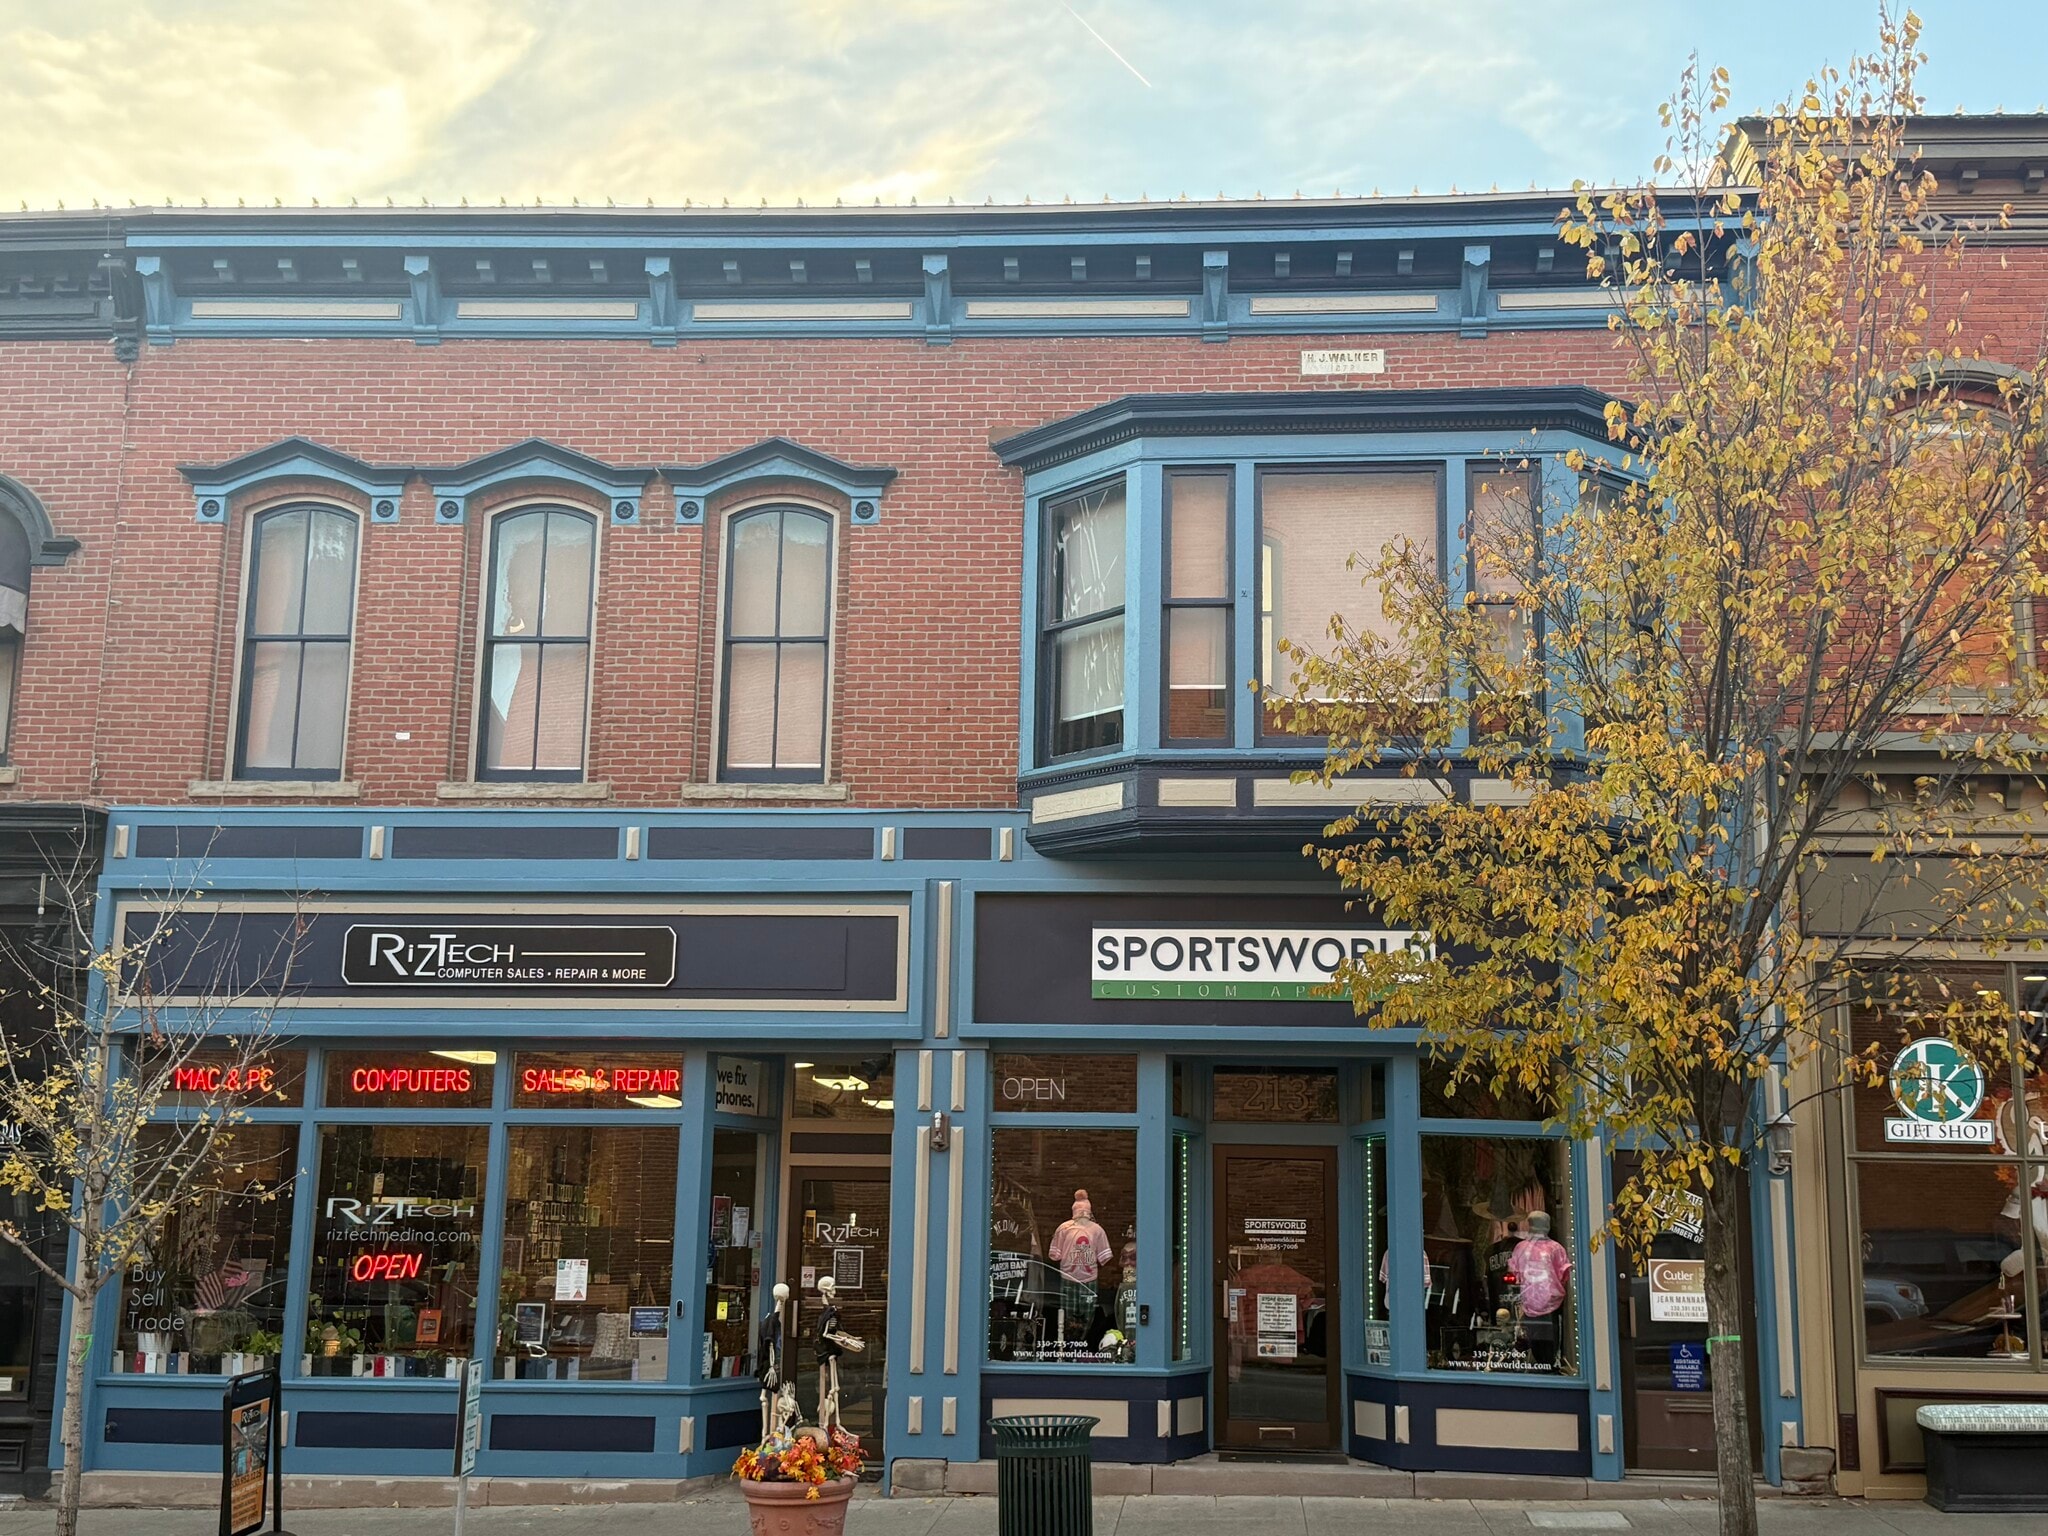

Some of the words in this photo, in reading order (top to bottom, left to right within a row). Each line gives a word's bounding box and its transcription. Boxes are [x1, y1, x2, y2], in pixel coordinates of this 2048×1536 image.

[438, 967, 503, 979] COMPUTER
[507, 968, 544, 979] SALES
[555, 968, 598, 979] REPAIR
[601, 969, 609, 979] &
[612, 968, 647, 979] MORE
[1101, 983, 1238, 997] CUSTOM
[175, 1067, 221, 1092] MAC
[227, 1067, 241, 1092] &
[248, 1068, 274, 1092] PC
[352, 1069, 471, 1092] COMPUTERS
[523, 1069, 587, 1092] SALES
[594, 1068, 607, 1092] &
[613, 1068, 680, 1092] REPAIR
[716, 1070, 734, 1084] we
[734, 1065, 748, 1086] fix
[715, 1085, 755, 1108] phones.
[1002, 1077, 1065, 1100] OPEN
[1242, 1077, 1312, 1112] 213
[1890, 1123, 1934, 1138] GIFT
[1938, 1124, 1989, 1140] SHOP
[327, 1227, 471, 1242] riztechmedina.com
[1244, 1221, 1307, 1230] SPORTSWORLD
[132, 1264, 166, 1286] Buy
[353, 1252, 423, 1281] OPEN
[1663, 1269, 1694, 1281] Cutler
[130, 1287, 164, 1306] Sell
[1657, 1295, 1674, 1303] JEAN
[129, 1311, 185, 1331] Trade
[1013, 1349, 1034, 1357] www.
[1036, 1340, 1088, 1348] 330-725-7006
[1448, 1360, 1471, 1368] www.
